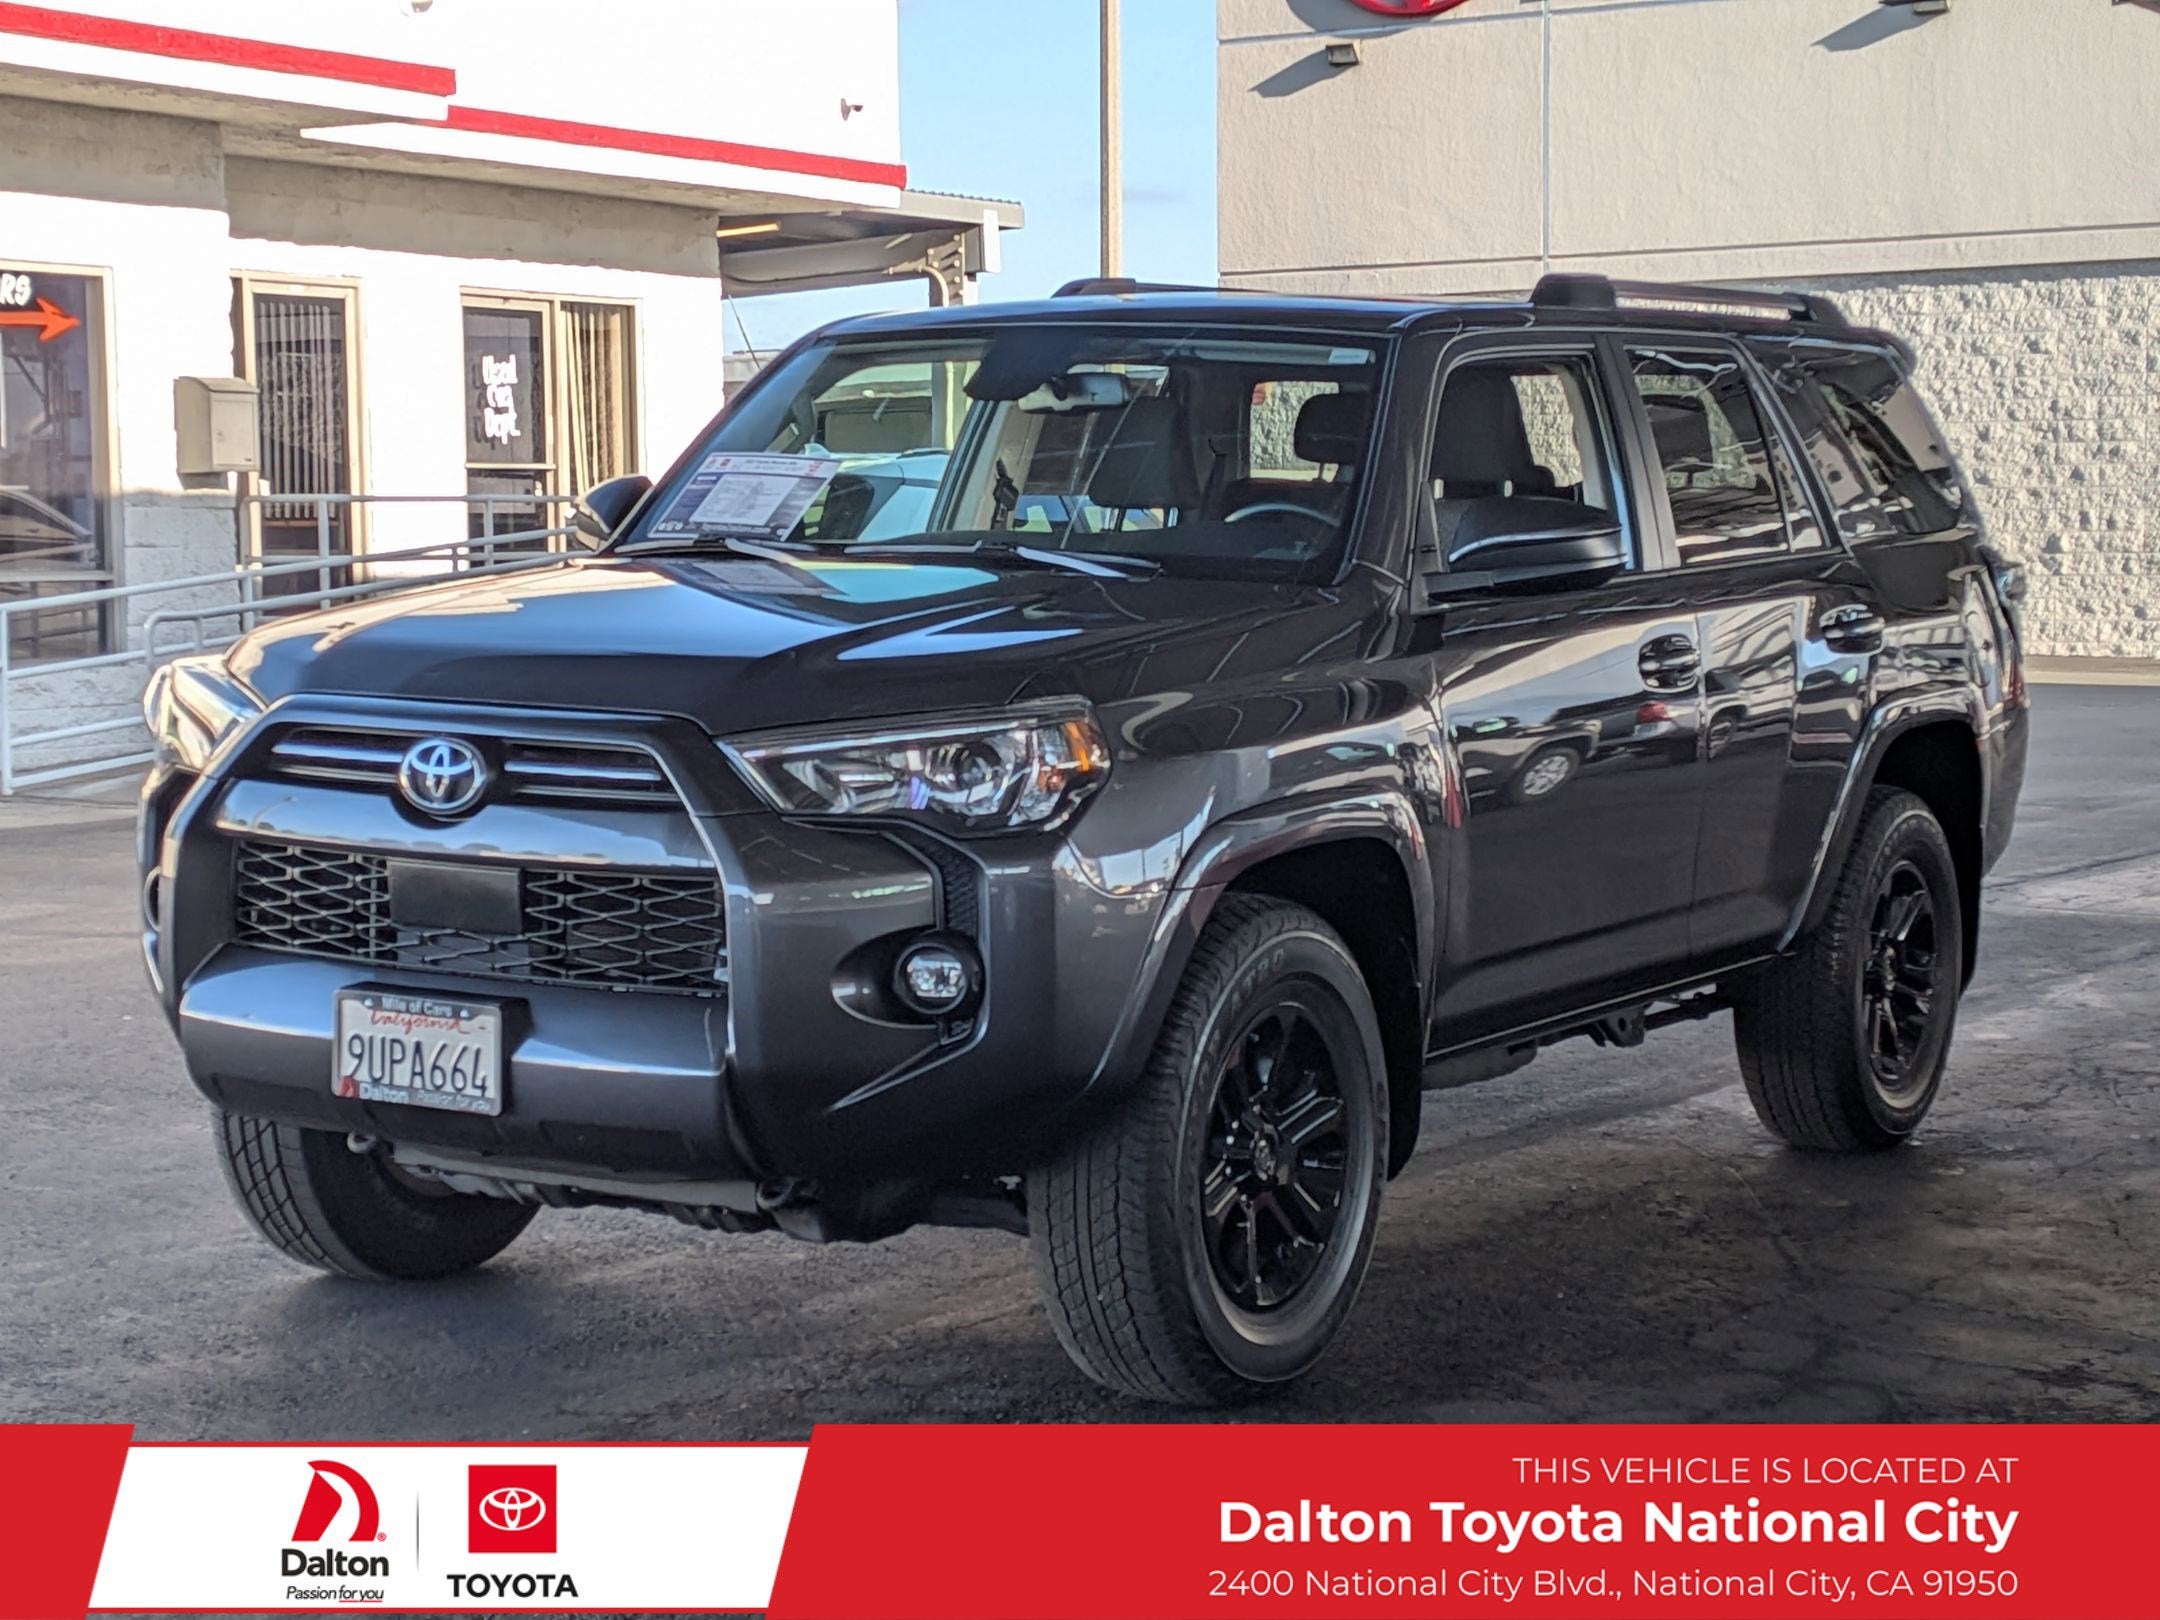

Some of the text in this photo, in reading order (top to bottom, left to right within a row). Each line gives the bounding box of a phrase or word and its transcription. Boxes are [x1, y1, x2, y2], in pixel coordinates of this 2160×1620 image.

[483, 354, 518, 385] Used
[409, 1000, 423, 1014] of
[349, 1033, 487, 1097] 9UPA664
[359, 1083, 409, 1104] Dalton
